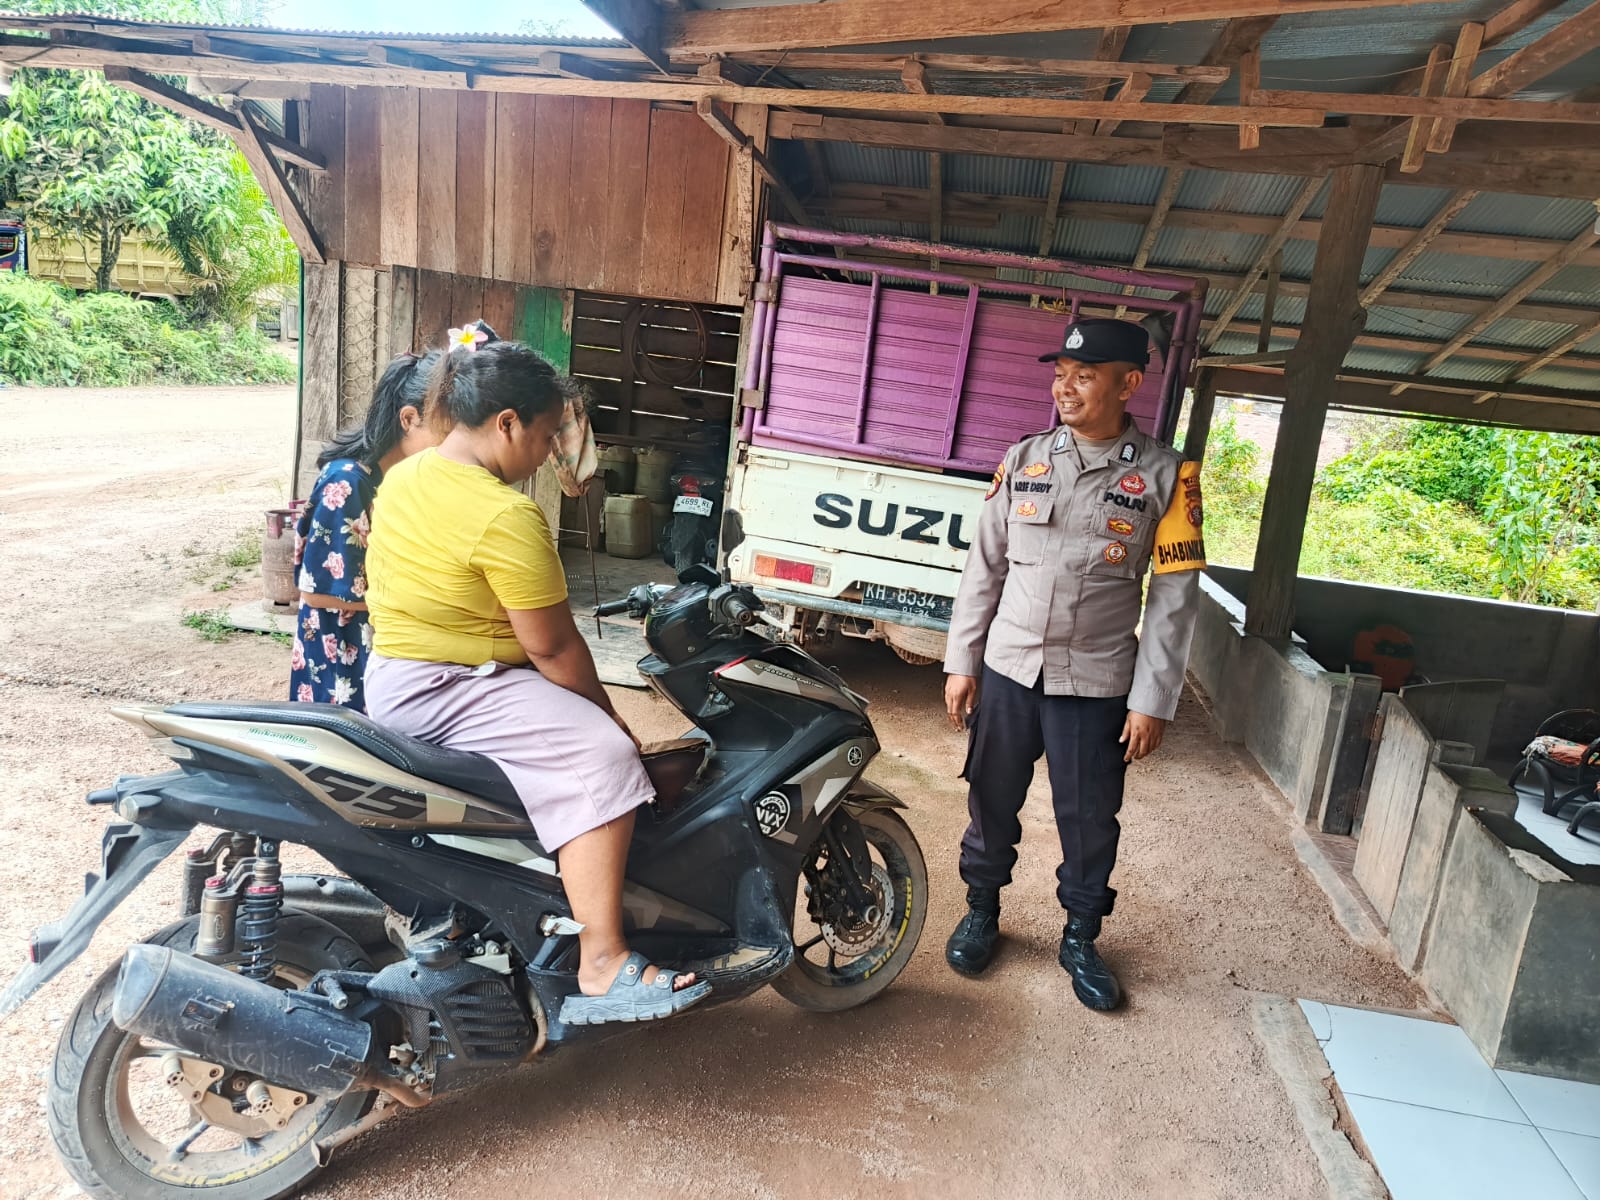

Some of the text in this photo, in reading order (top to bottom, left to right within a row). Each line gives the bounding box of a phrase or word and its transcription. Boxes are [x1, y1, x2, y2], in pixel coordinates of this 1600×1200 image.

[1030, 482, 1053, 494] DEDY
[1103, 490, 1147, 513] POLRI
[865, 582, 887, 601] KH
